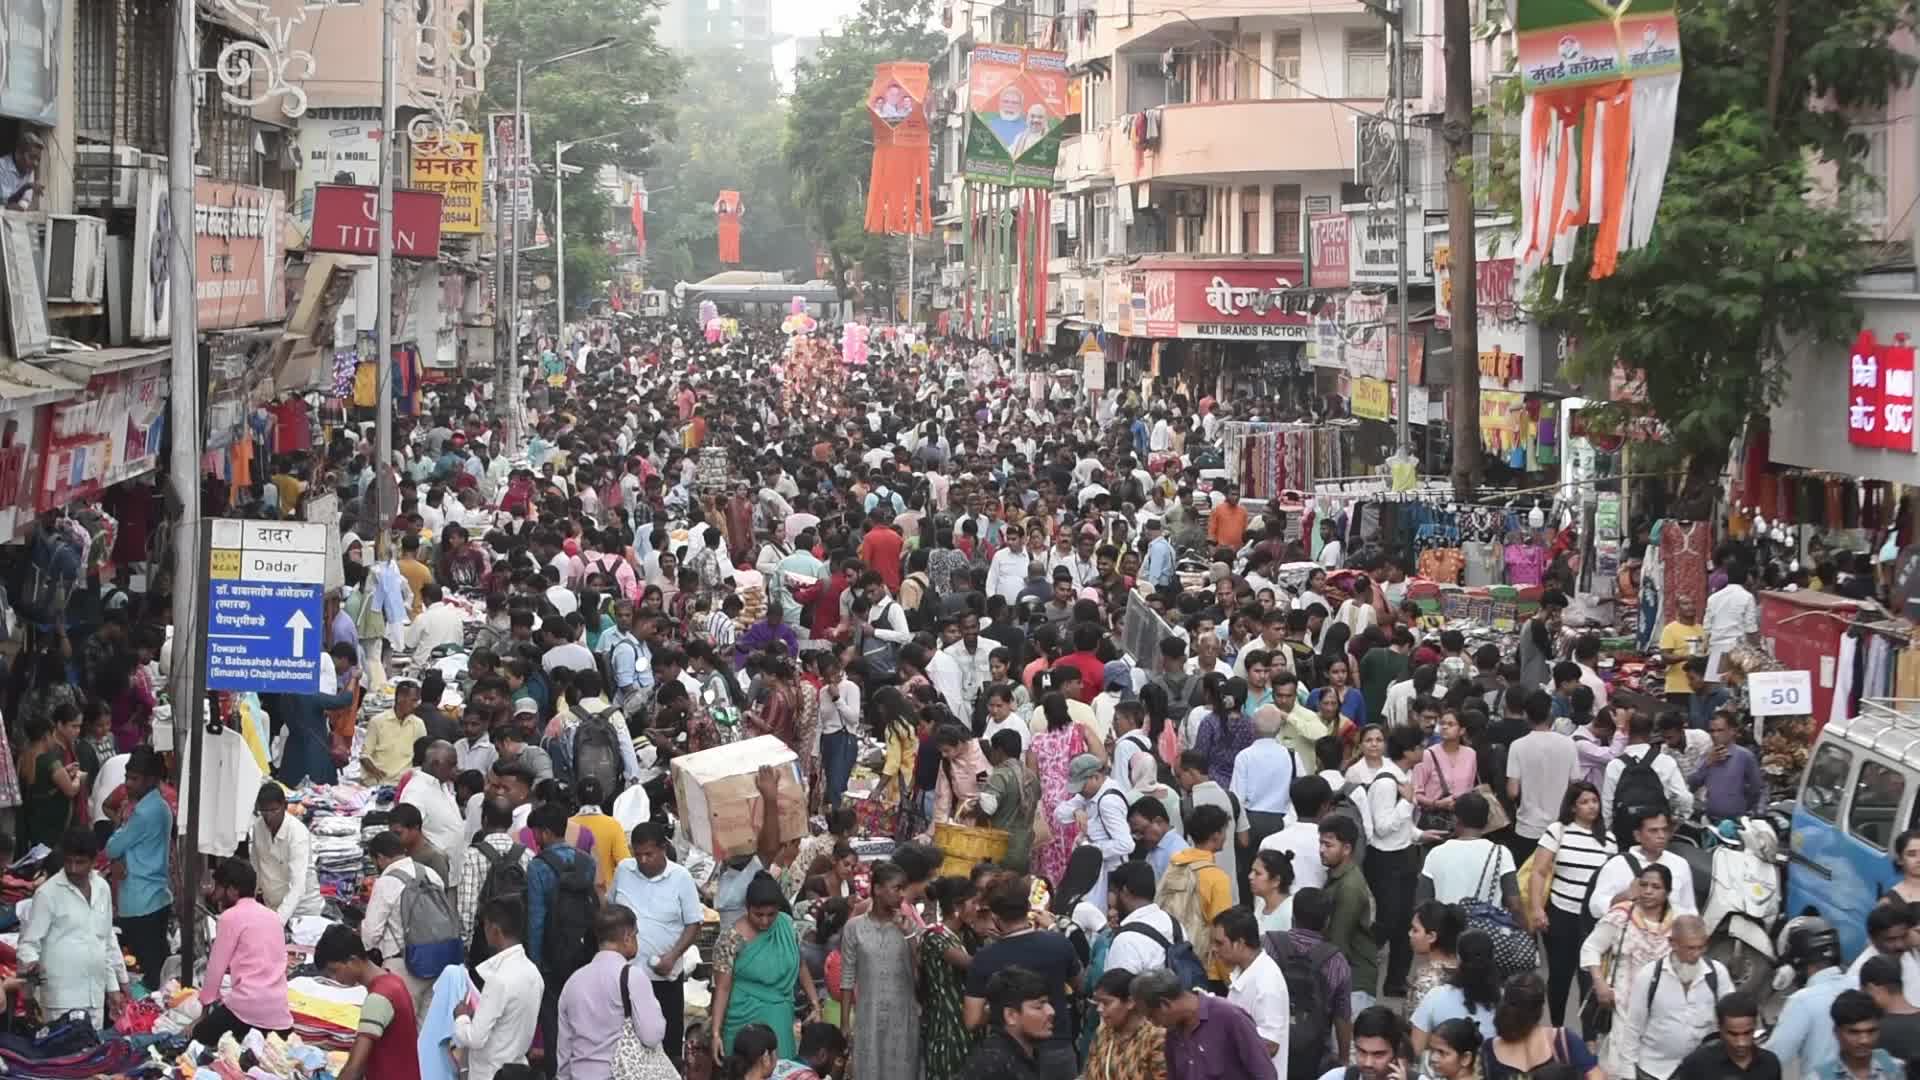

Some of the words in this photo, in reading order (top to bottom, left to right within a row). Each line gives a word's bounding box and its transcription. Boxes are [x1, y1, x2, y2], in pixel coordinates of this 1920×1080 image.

[337, 225, 415, 250] TITN
[1197, 325, 1218, 335] MULTI
[1220, 325, 1258, 336] BRANDS
[1261, 326, 1308, 337] FACTORY
[257, 528, 293, 542] दादर
[254, 559, 298, 572] Dadar
[211, 643, 247, 654] Towards
[211, 655, 223, 665] Dr.
[225, 656, 272, 667] Babasaheb
[273, 658, 316, 668] Ambedkar
[210, 667, 248, 678] (Smarak)
[249, 669, 313, 681] Chaityabhoomi
